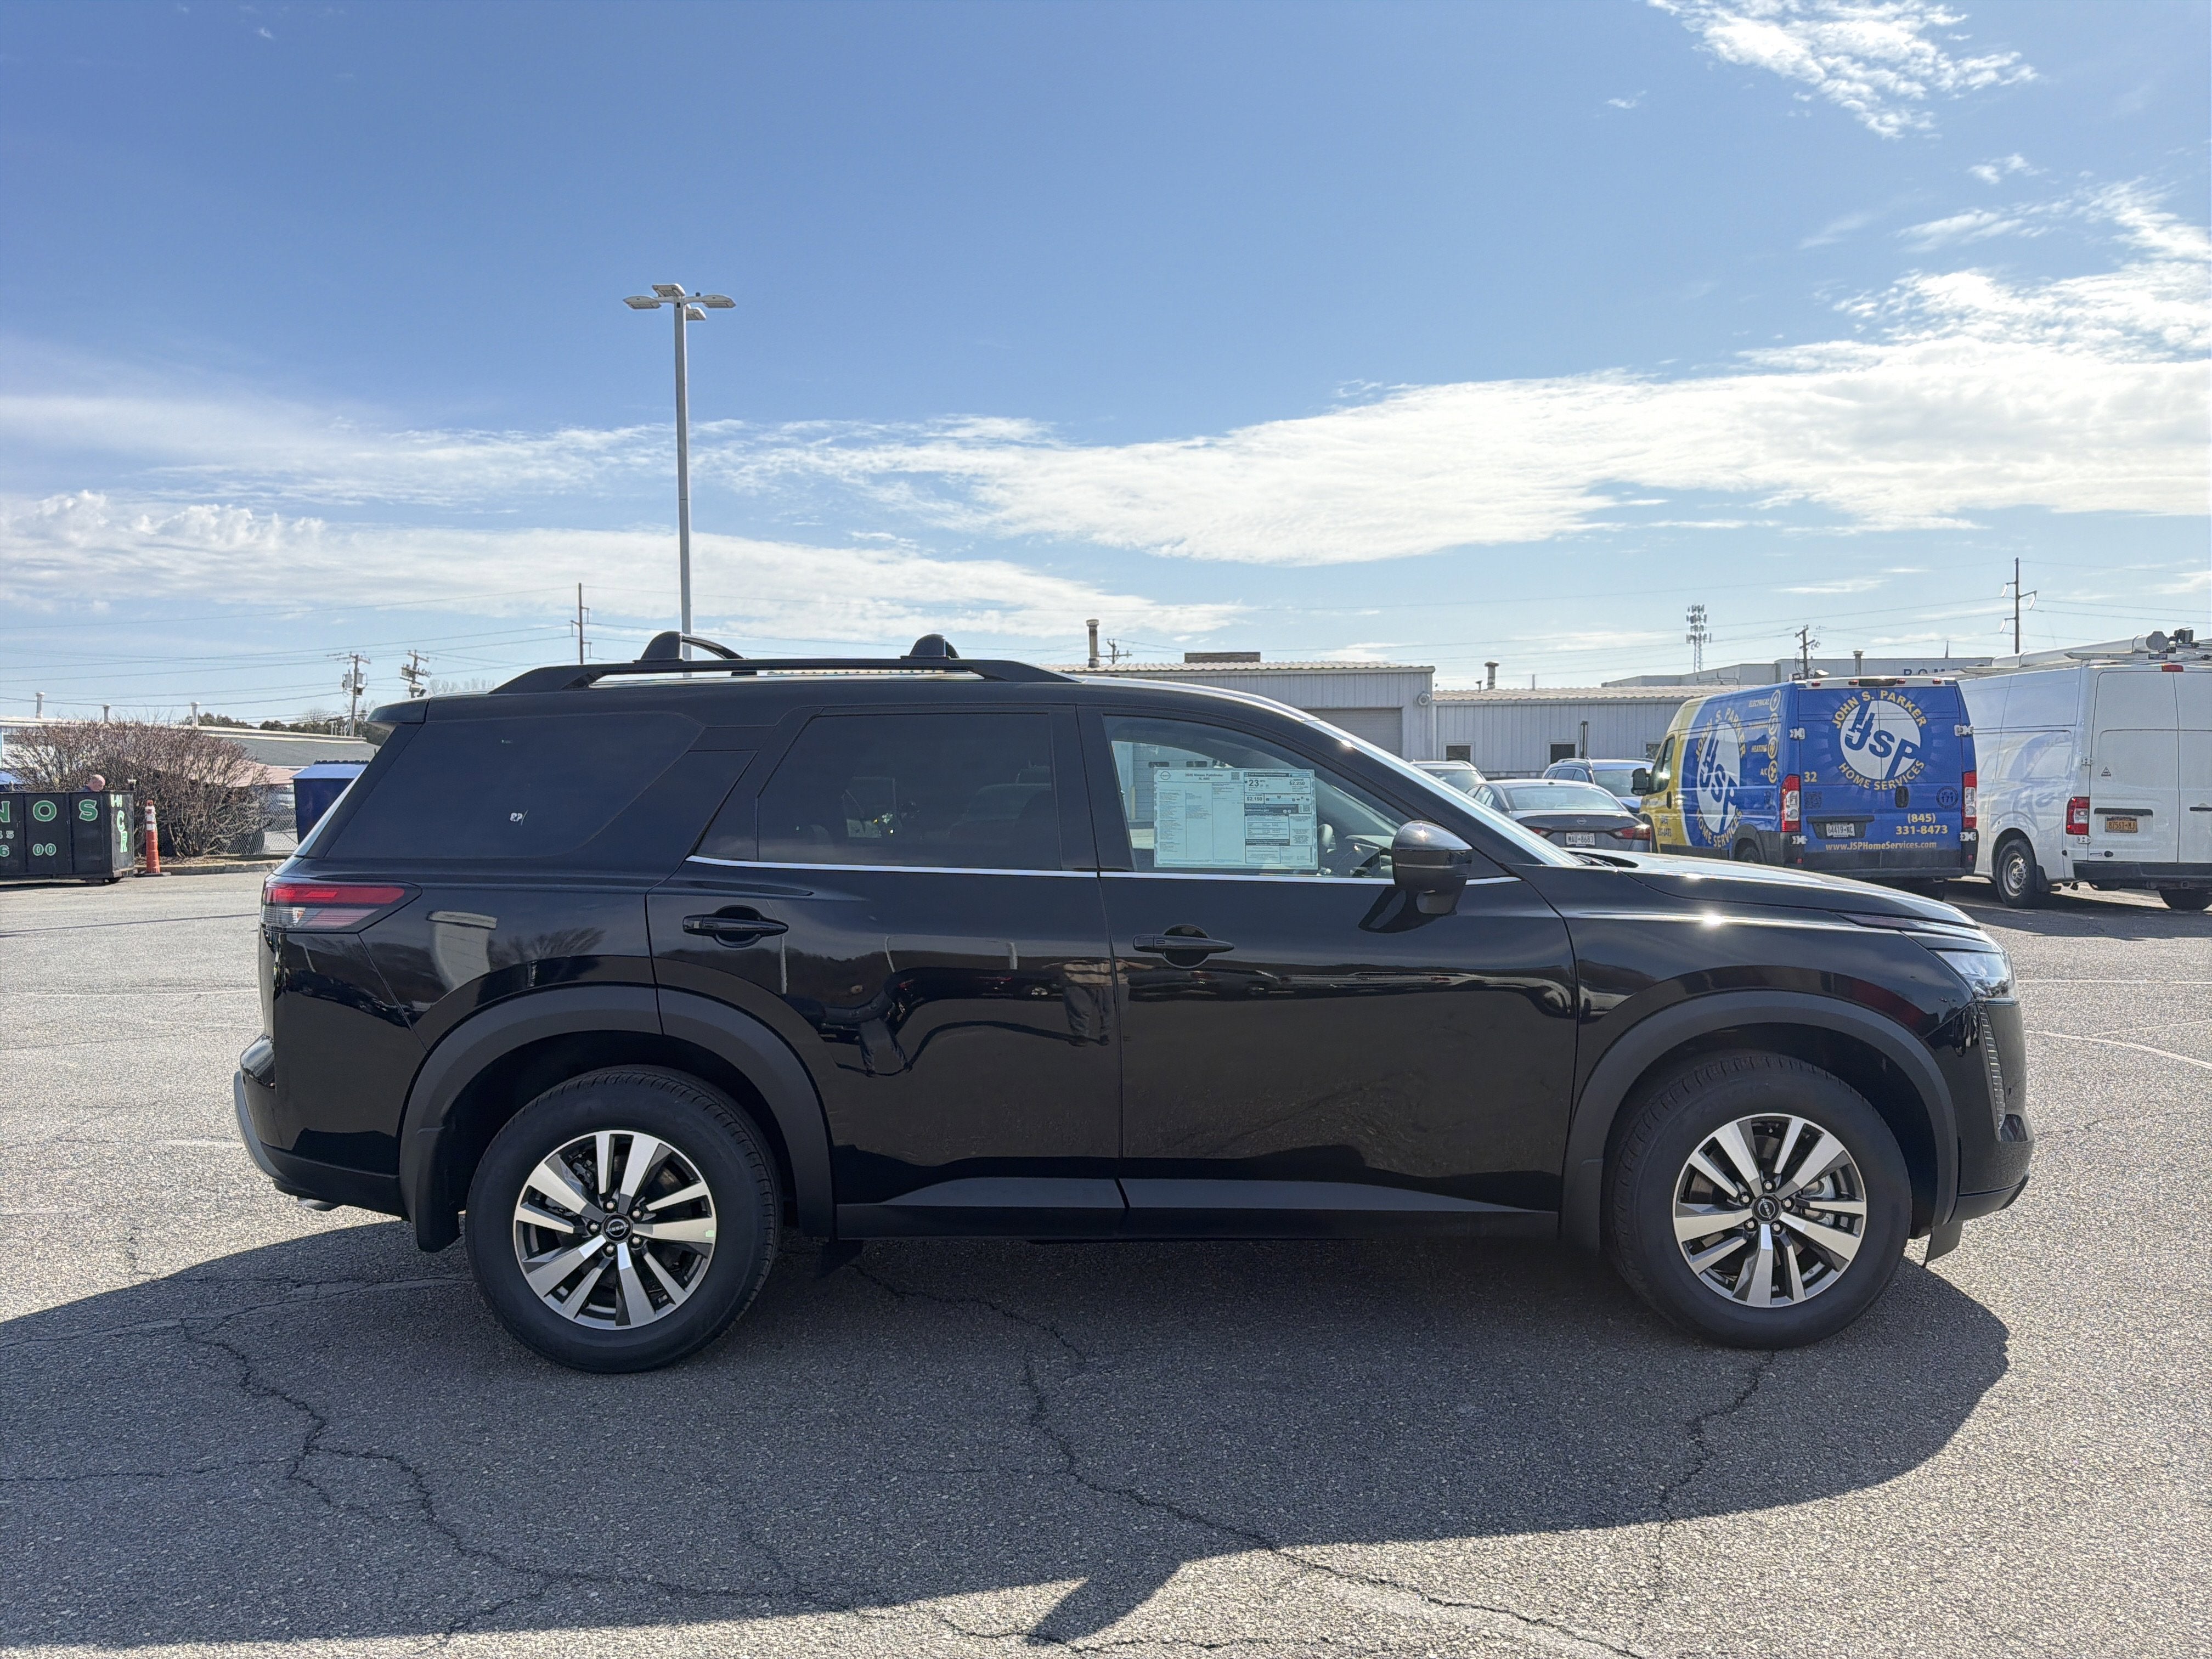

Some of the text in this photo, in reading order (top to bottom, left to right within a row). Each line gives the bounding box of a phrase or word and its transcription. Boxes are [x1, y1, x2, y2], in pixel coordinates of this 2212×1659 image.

[1832, 690, 1927, 729] JOHN S. PARKER
[1724, 707, 1746, 758] PARKER
[1804, 771, 1817, 782] 32
[1838, 760, 1925, 791] HOME SERVICES
[1713, 807, 1742, 848] SERVICES
[1907, 813, 1936, 823] (845)
[1895, 825, 1948, 835] 331-8473
[1825, 840, 1937, 850] www.JSPHomeServices.com
